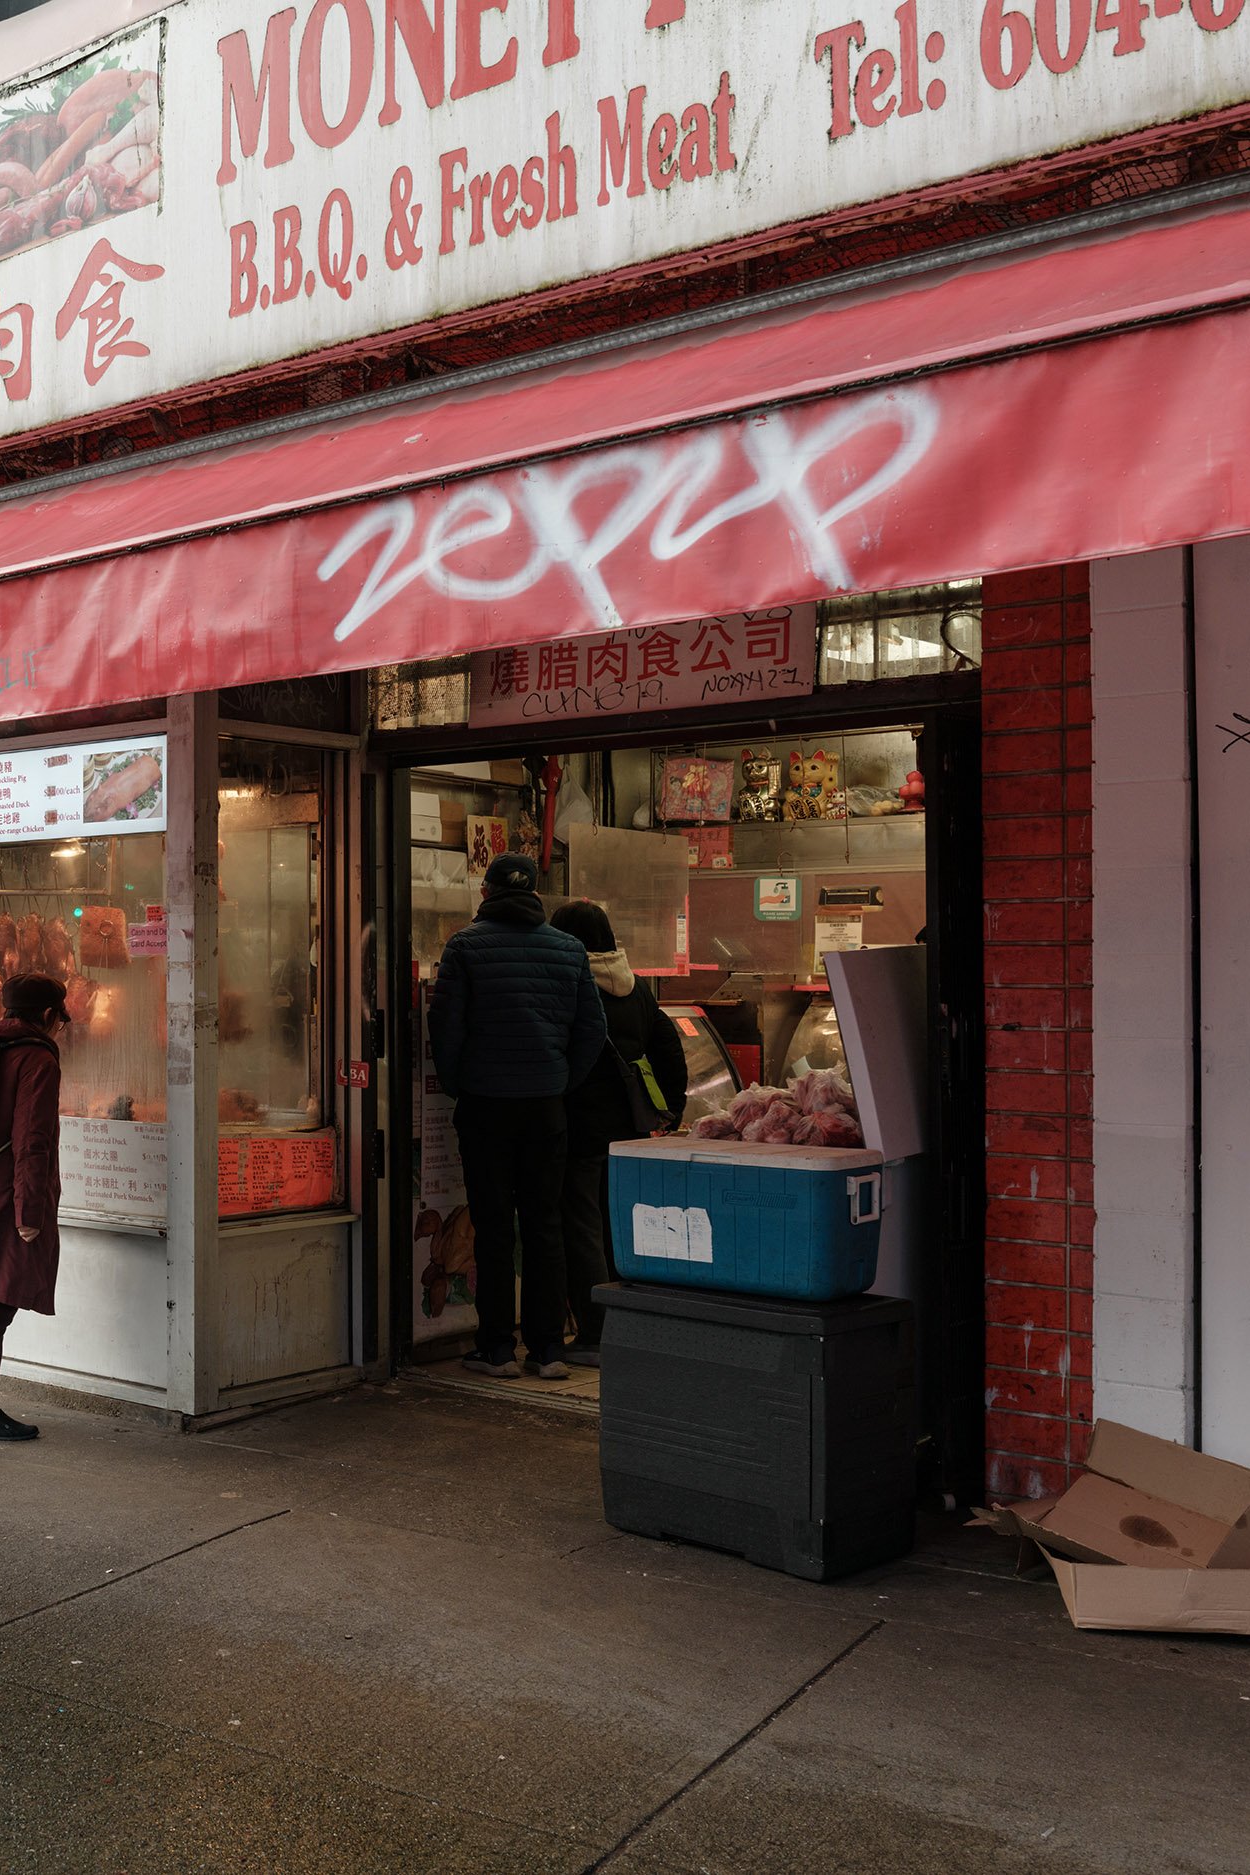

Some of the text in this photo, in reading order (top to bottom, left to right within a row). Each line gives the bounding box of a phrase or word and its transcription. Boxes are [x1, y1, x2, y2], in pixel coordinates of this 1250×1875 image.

[815, 0, 1245, 143] Tel: 604-
[230, 71, 736, 318] B.B.Q. & Fresh Meat
[22, 825, 45, 833] Chicken
[83, 1136, 127, 1146] Marinated Duck
[83, 1163, 137, 1173] Marinated Intestine
[85, 1190, 112, 1199] Marinated
